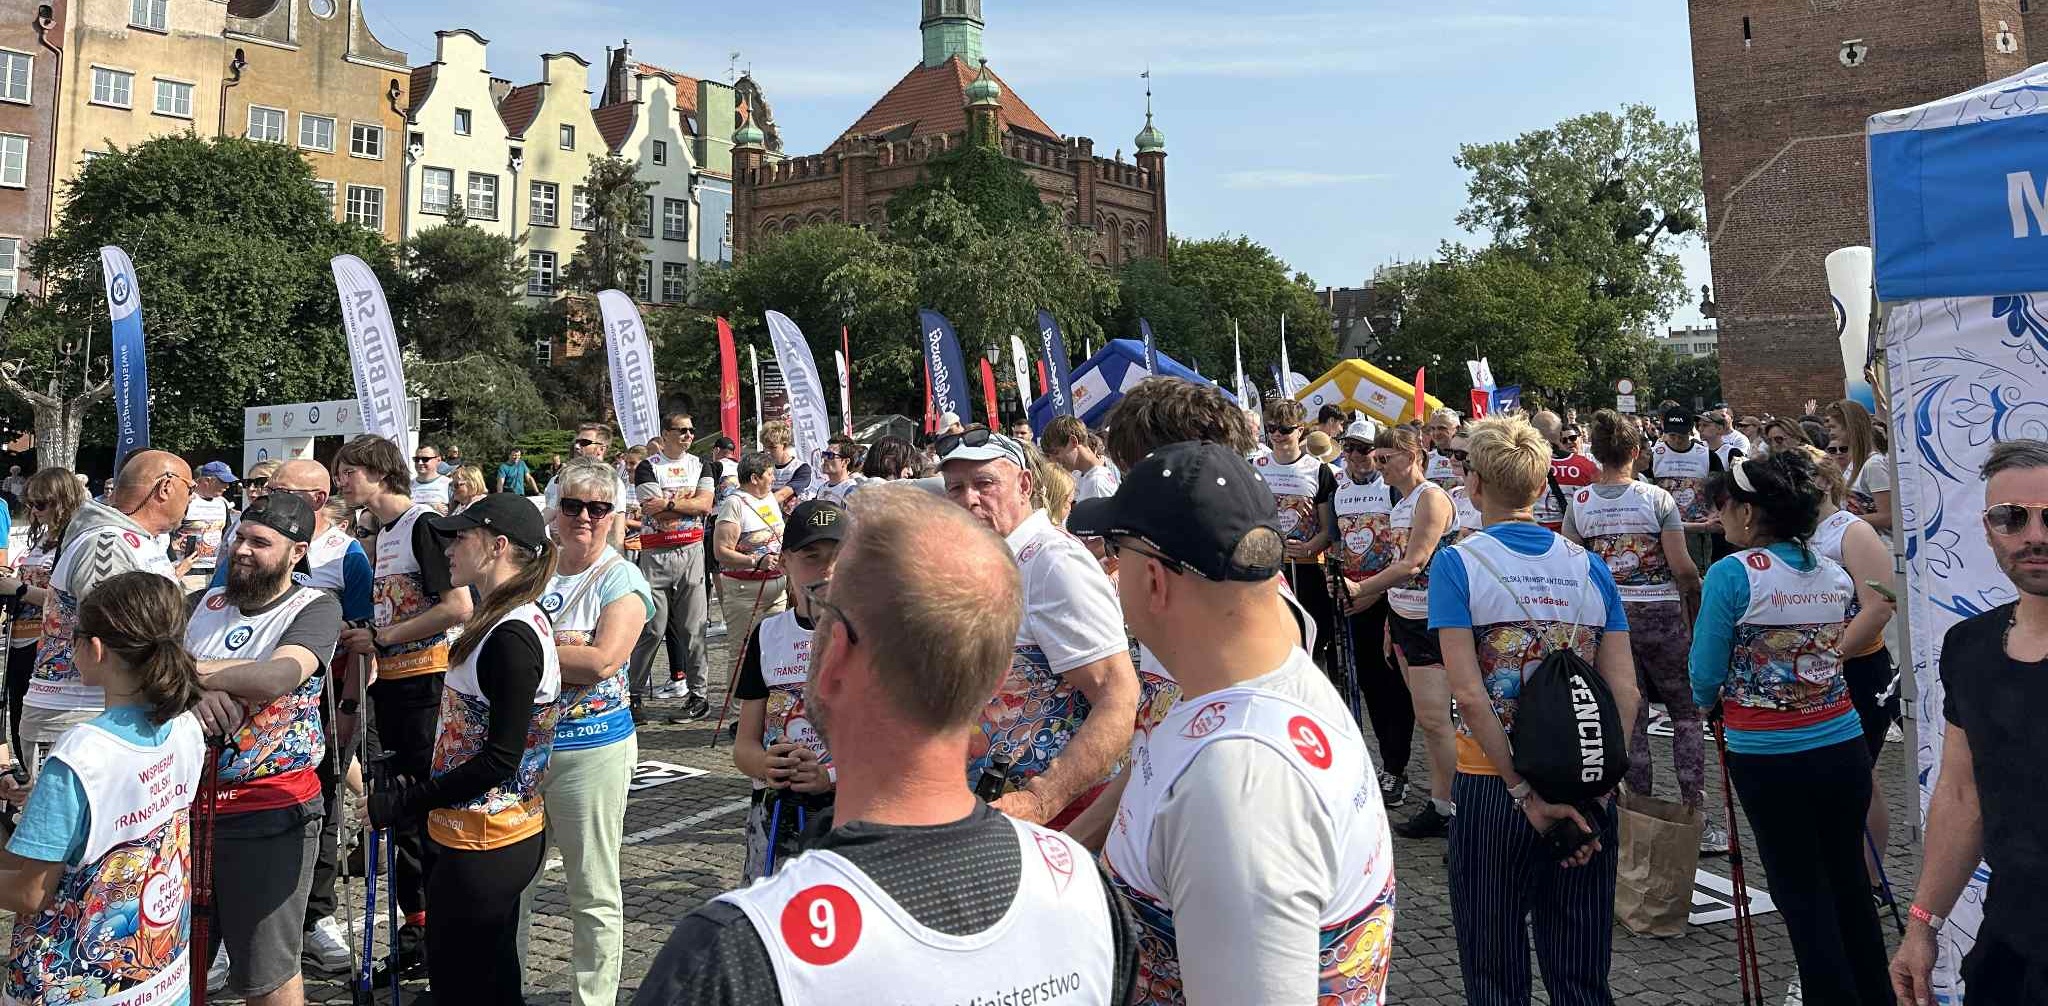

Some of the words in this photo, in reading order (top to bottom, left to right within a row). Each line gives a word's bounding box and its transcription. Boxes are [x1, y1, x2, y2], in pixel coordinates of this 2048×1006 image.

[1751, 555, 1765, 567] 17
[1784, 594, 1818, 604] NOWY
[231, 632, 251, 644] PZU
[576, 721, 609, 737] 2025
[1570, 674, 1604, 783] FENCING
[1290, 725, 1326, 759] 9
[202, 789, 238, 801] NWE
[808, 898, 836, 948] 9
[134, 992, 152, 1006] dla
